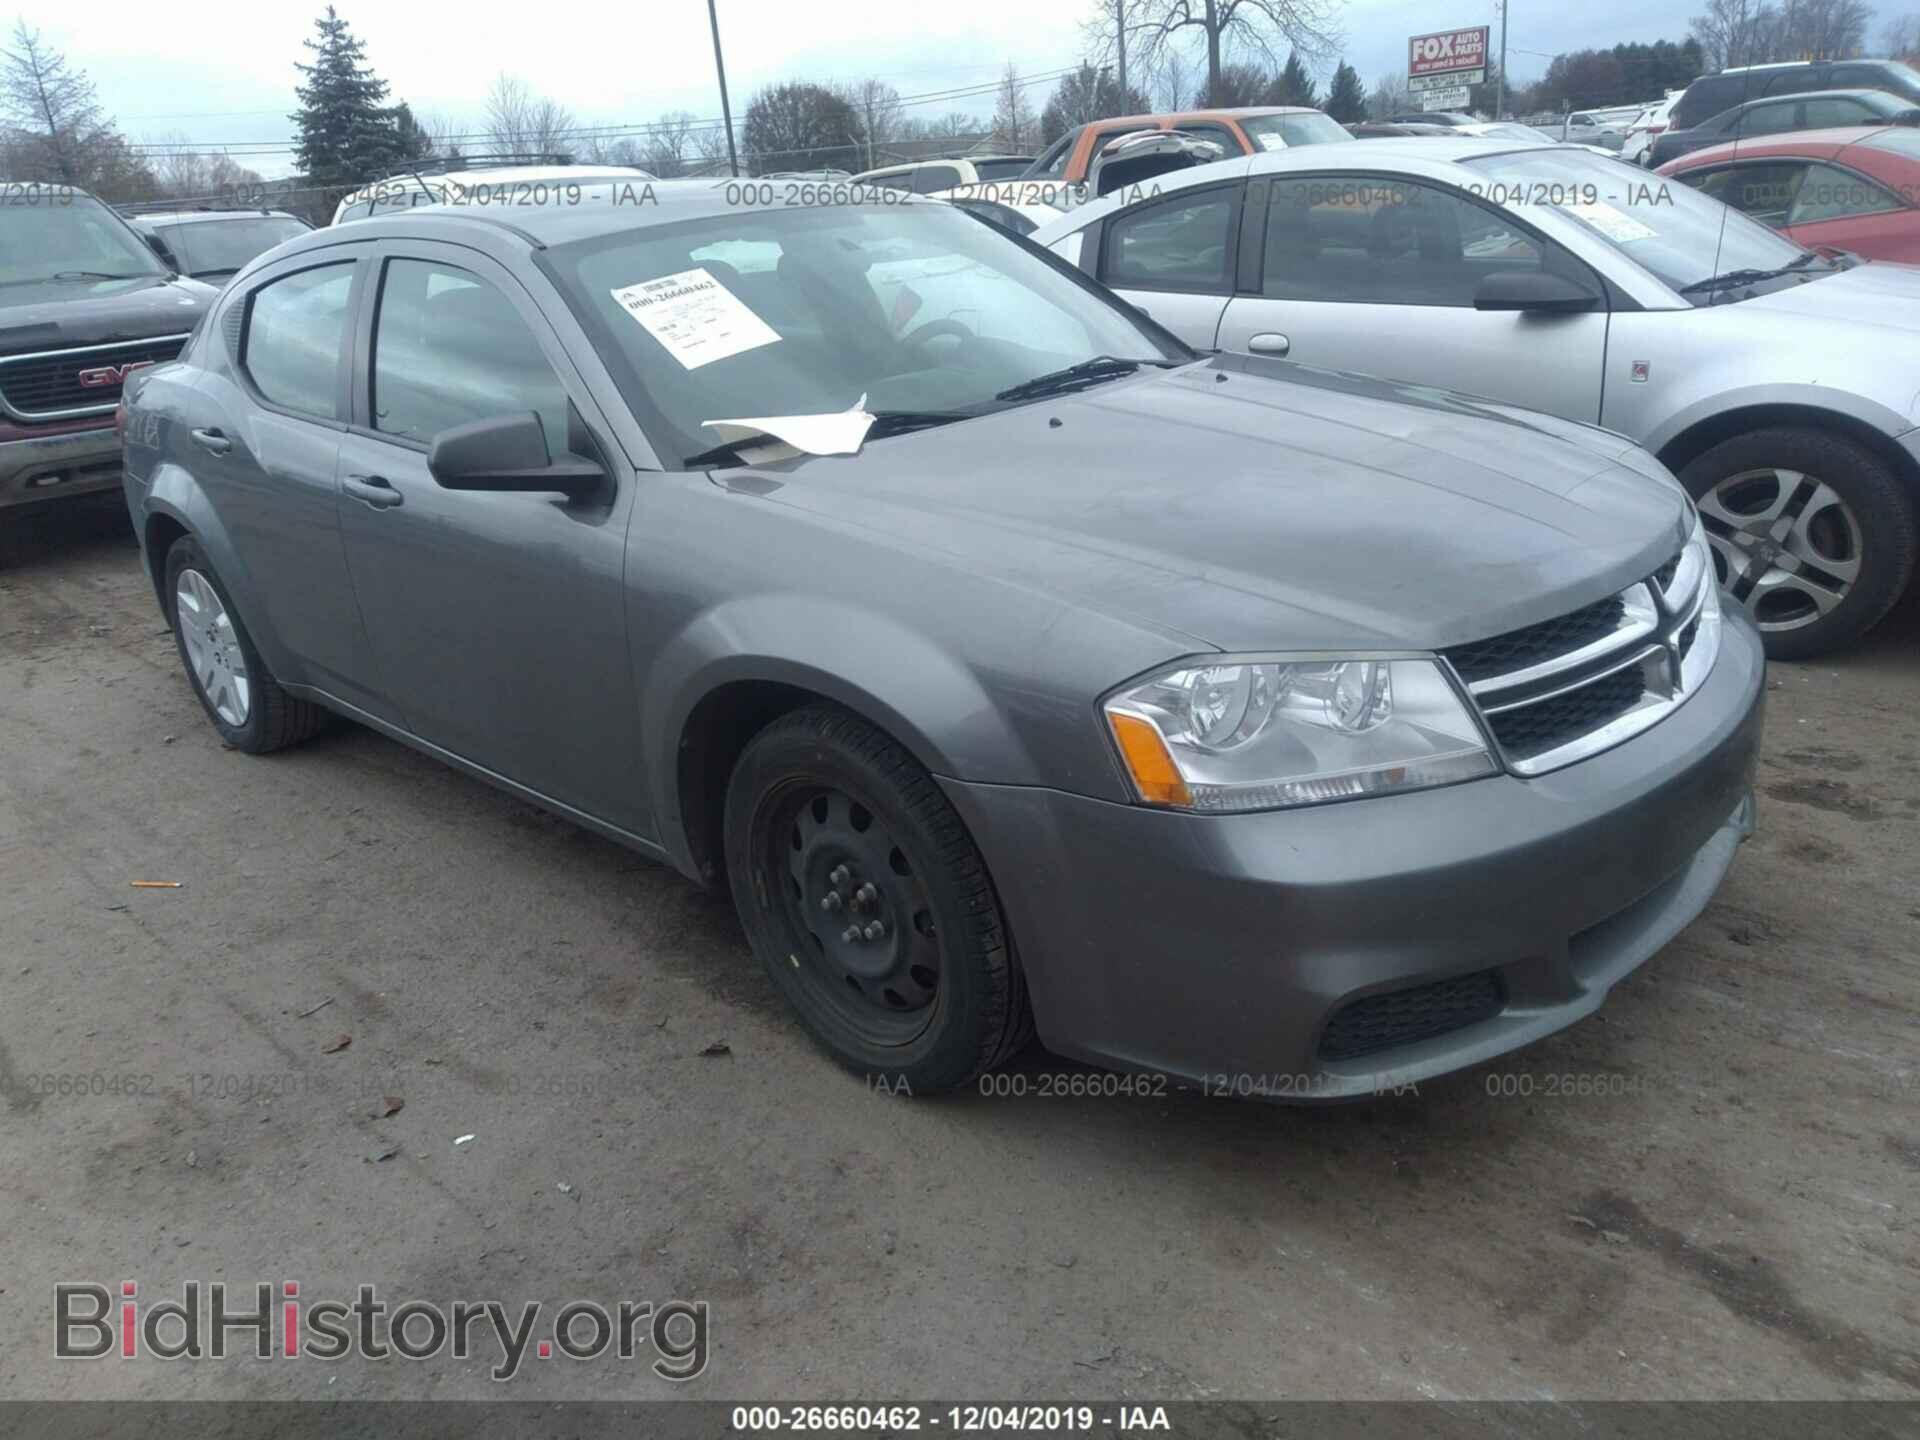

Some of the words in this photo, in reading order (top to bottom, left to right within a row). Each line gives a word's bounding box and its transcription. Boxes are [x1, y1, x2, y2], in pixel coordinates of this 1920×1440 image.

[1455, 31, 1480, 44] AUTO
[1412, 35, 1454, 62] FOX
[1455, 42, 1482, 55] PARTS
[79, 361, 155, 388] GM
